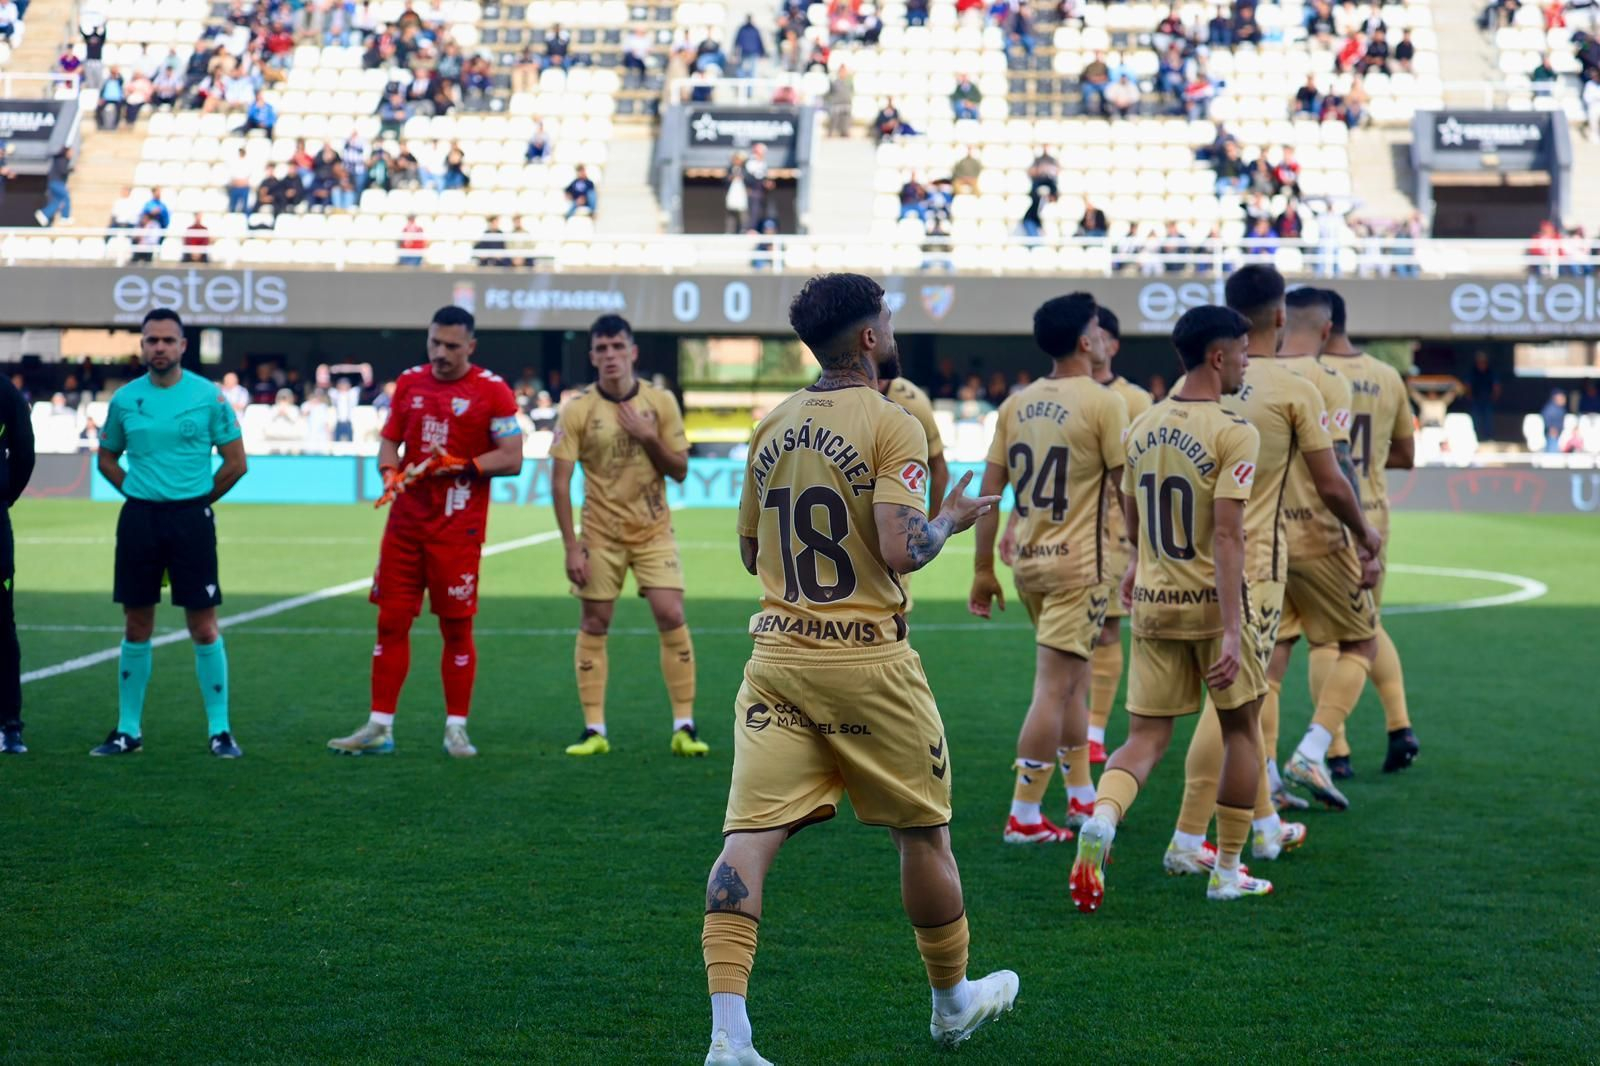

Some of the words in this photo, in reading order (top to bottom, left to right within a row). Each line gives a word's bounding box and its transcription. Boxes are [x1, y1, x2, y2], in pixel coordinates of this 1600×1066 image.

[113, 268, 287, 313] estels
[673, 281, 700, 322] 0
[724, 281, 750, 322] 0
[1138, 276, 1227, 321] est
[1450, 275, 1600, 321] estel
[1017, 401, 1069, 425] LOBETE
[783, 418, 876, 497] SÁNCHEZ
[1135, 427, 1216, 477] LARRUBIA
[1008, 441, 1069, 523] 24
[1139, 472, 1197, 561] 10
[764, 485, 858, 604] 18
[753, 615, 876, 643] BENAHAVIS
[839, 723, 871, 736] SOL
